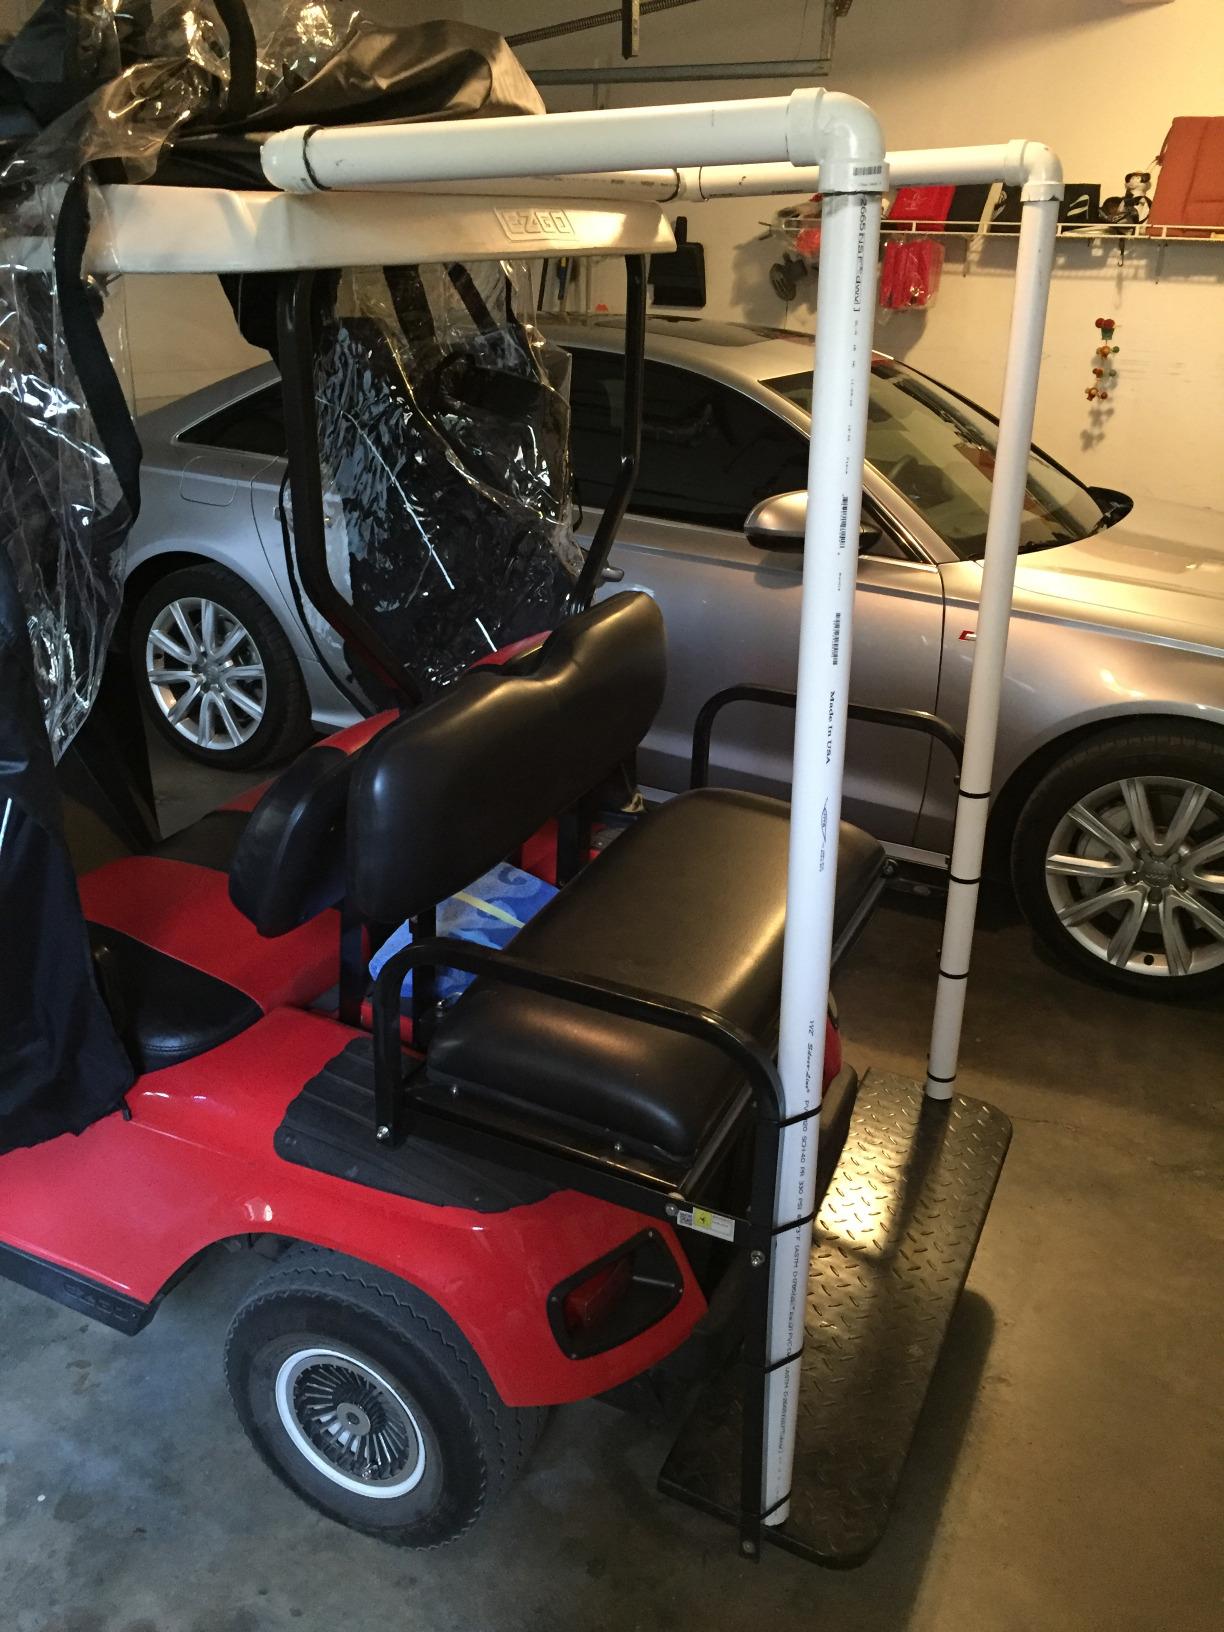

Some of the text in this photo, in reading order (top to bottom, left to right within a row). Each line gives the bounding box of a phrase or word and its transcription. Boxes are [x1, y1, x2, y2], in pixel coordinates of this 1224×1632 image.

[825, 691, 836, 765] Made In USA
